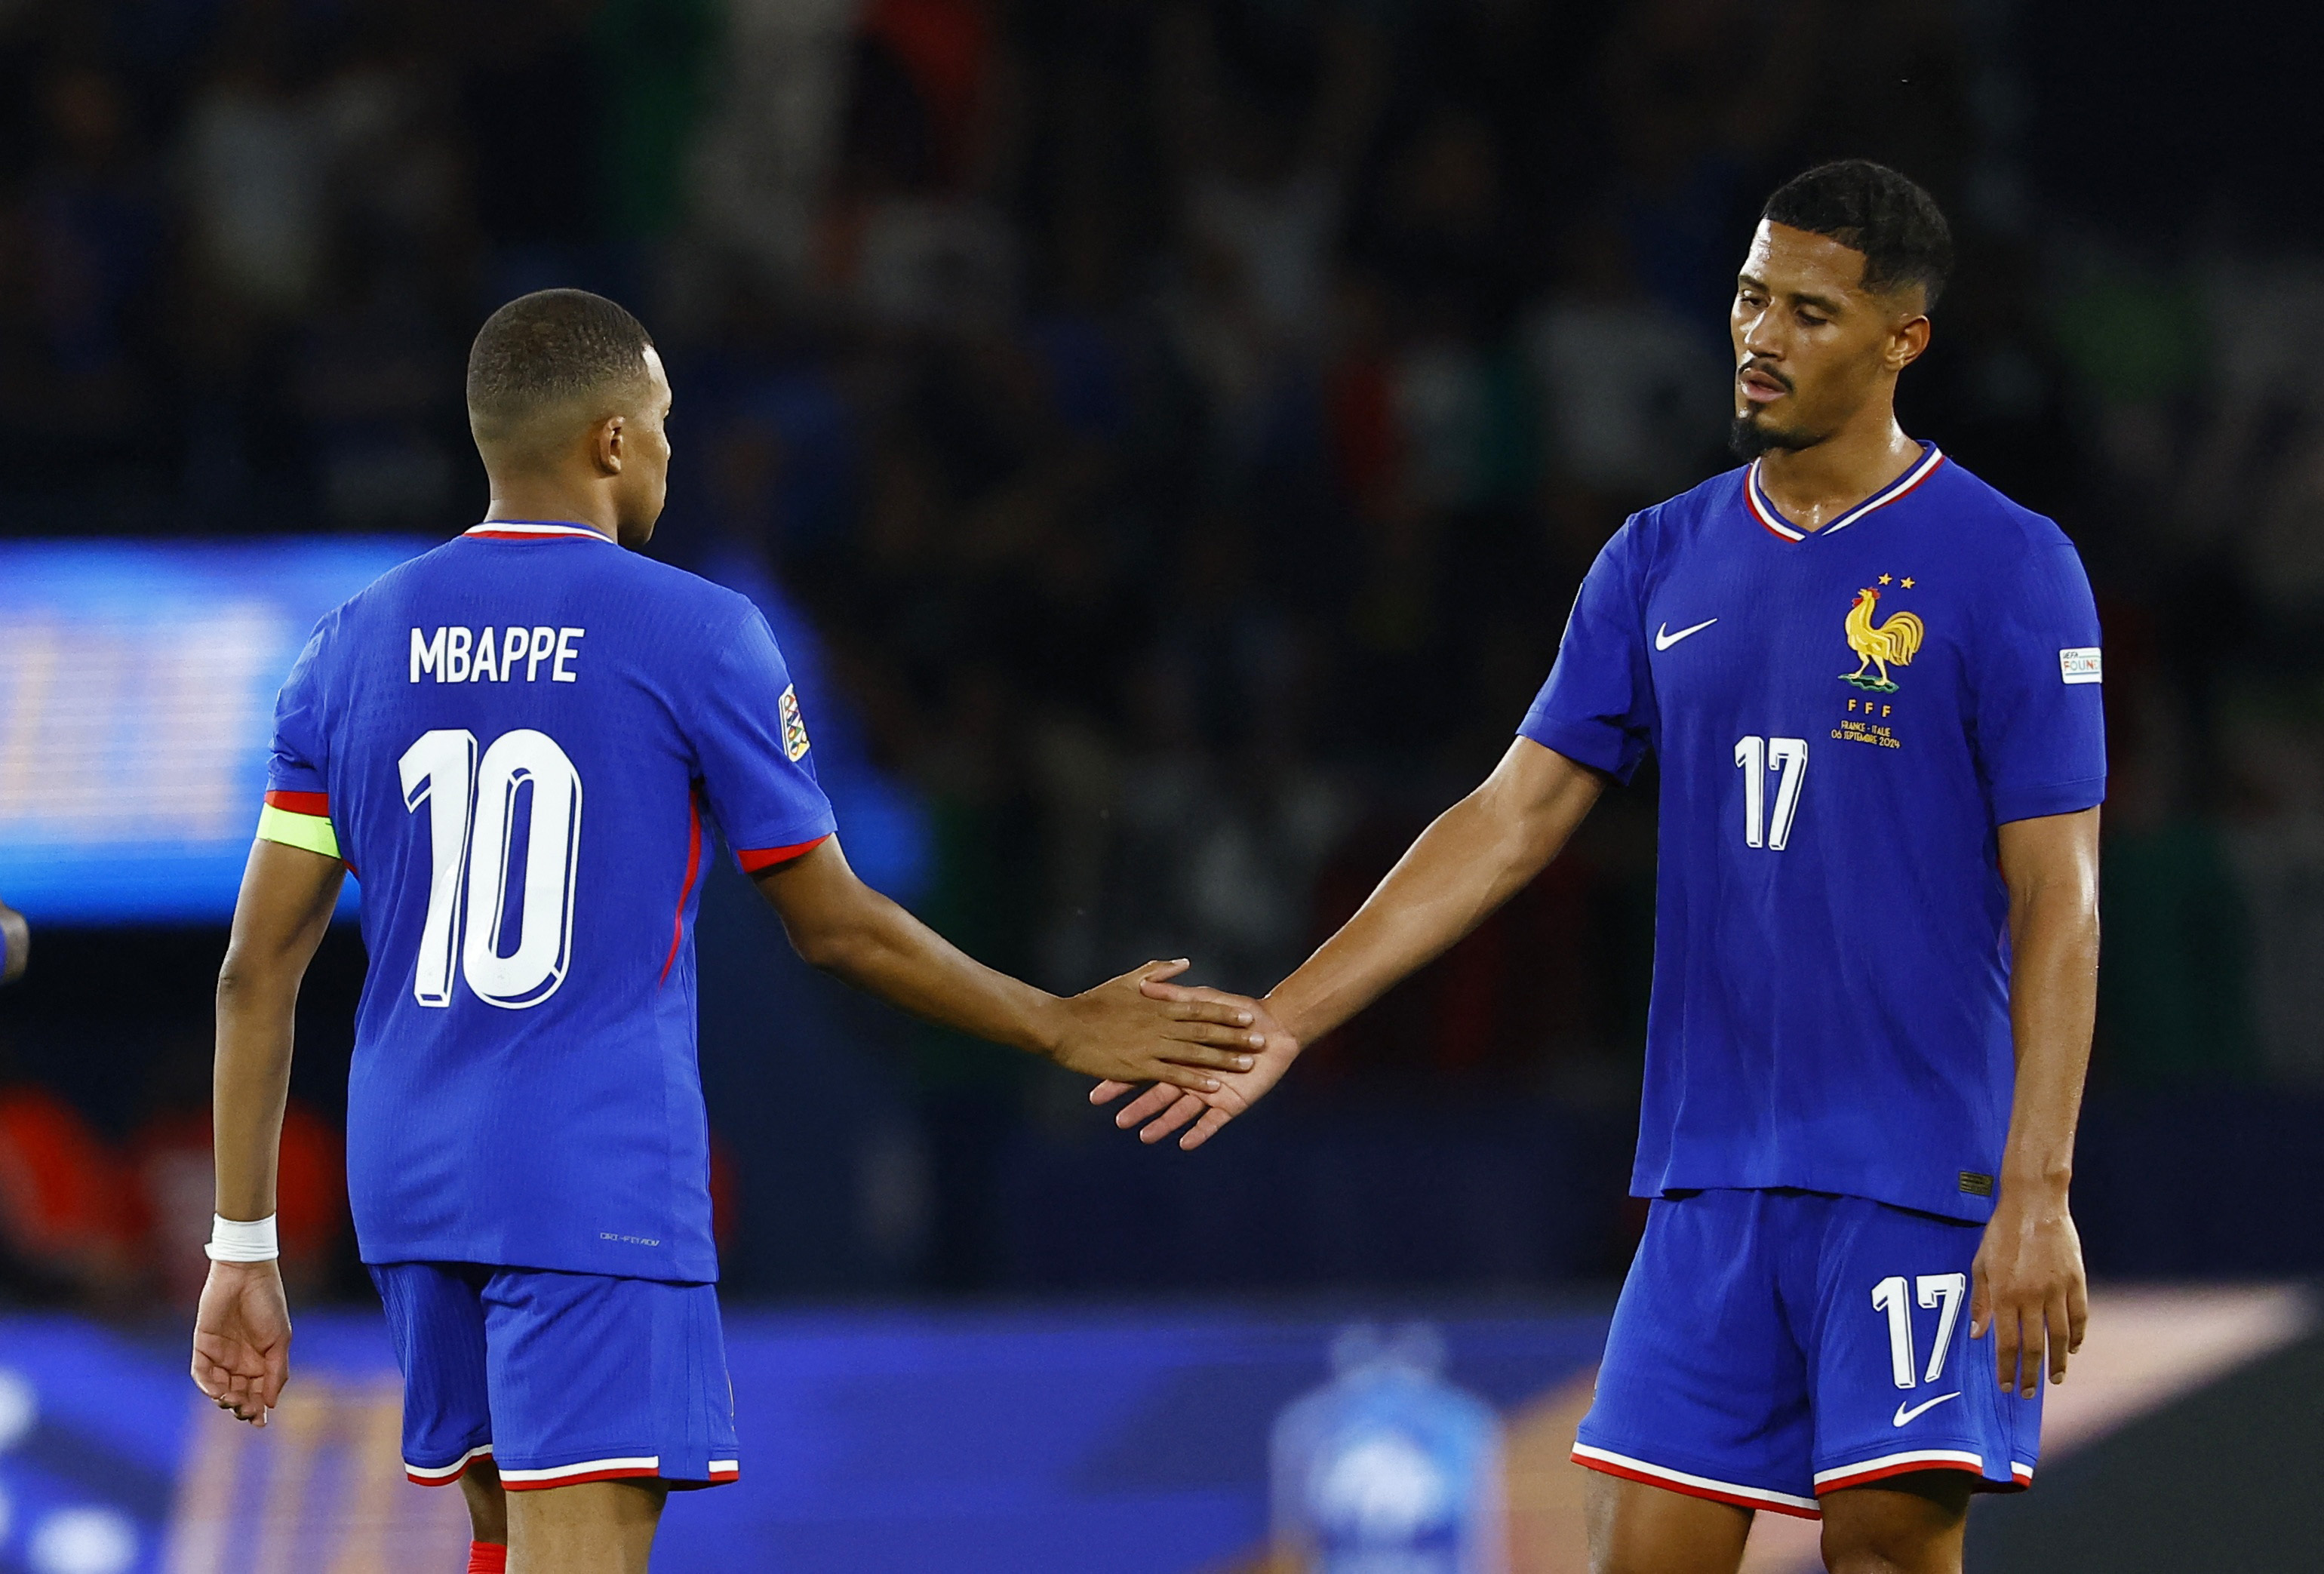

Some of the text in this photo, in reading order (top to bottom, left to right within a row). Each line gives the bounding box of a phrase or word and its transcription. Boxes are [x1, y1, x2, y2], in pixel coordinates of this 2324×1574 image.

[409, 626, 586, 683] MBAPPE
[1831, 729, 1842, 739] 06
[1878, 736, 1901, 749] 2024
[1841, 720, 1866, 733] FRANCE
[1871, 724, 1891, 737] ITALIE
[1734, 736, 1808, 851] 17
[398, 728, 583, 1009] 10
[1871, 1272, 1966, 1389] 17
